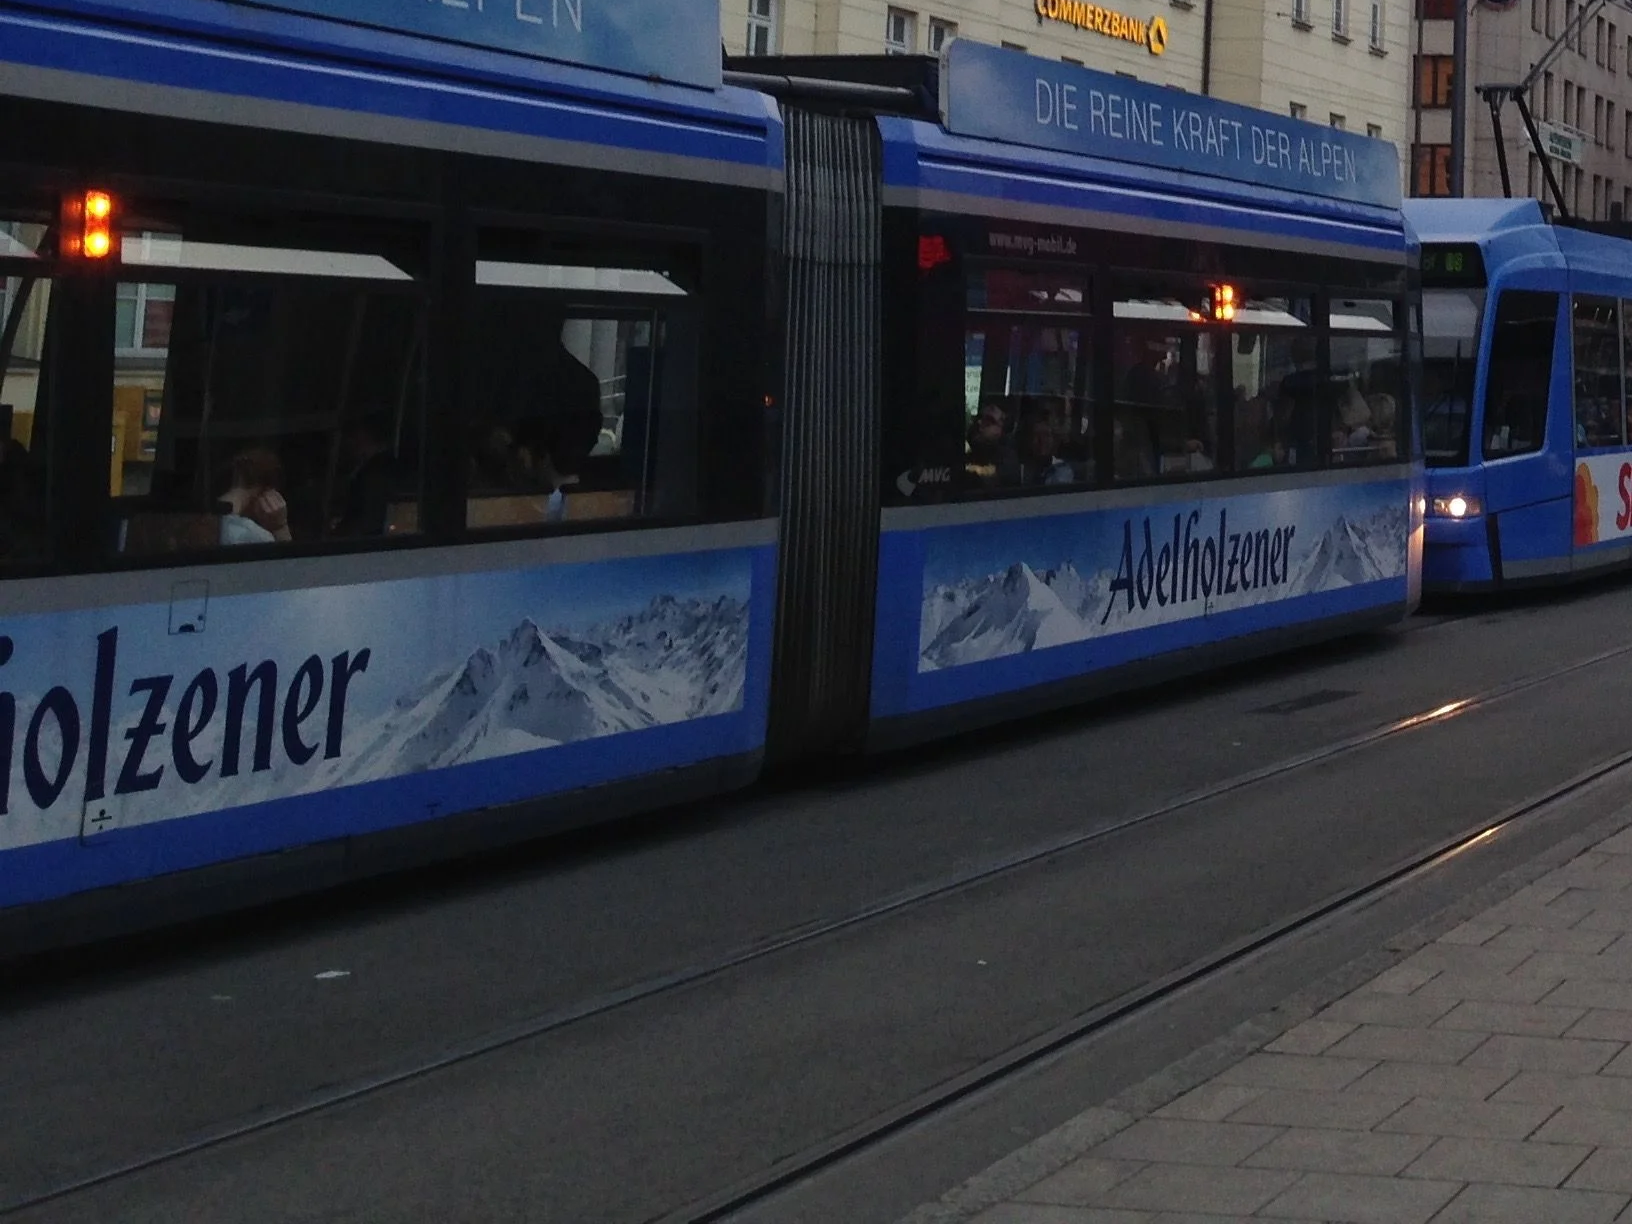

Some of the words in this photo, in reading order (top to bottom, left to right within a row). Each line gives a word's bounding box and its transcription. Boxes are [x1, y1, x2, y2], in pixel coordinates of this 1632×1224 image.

[1035, 78, 1078, 131] DIE
[1090, 90, 1164, 147] REINE
[1172, 108, 1242, 160] KRAFT
[1252, 125, 1291, 171] DER
[1299, 137, 1357, 183] ALPEN
[918, 467, 950, 483] MVG
[1101, 509, 1296, 626] Adelholzener
